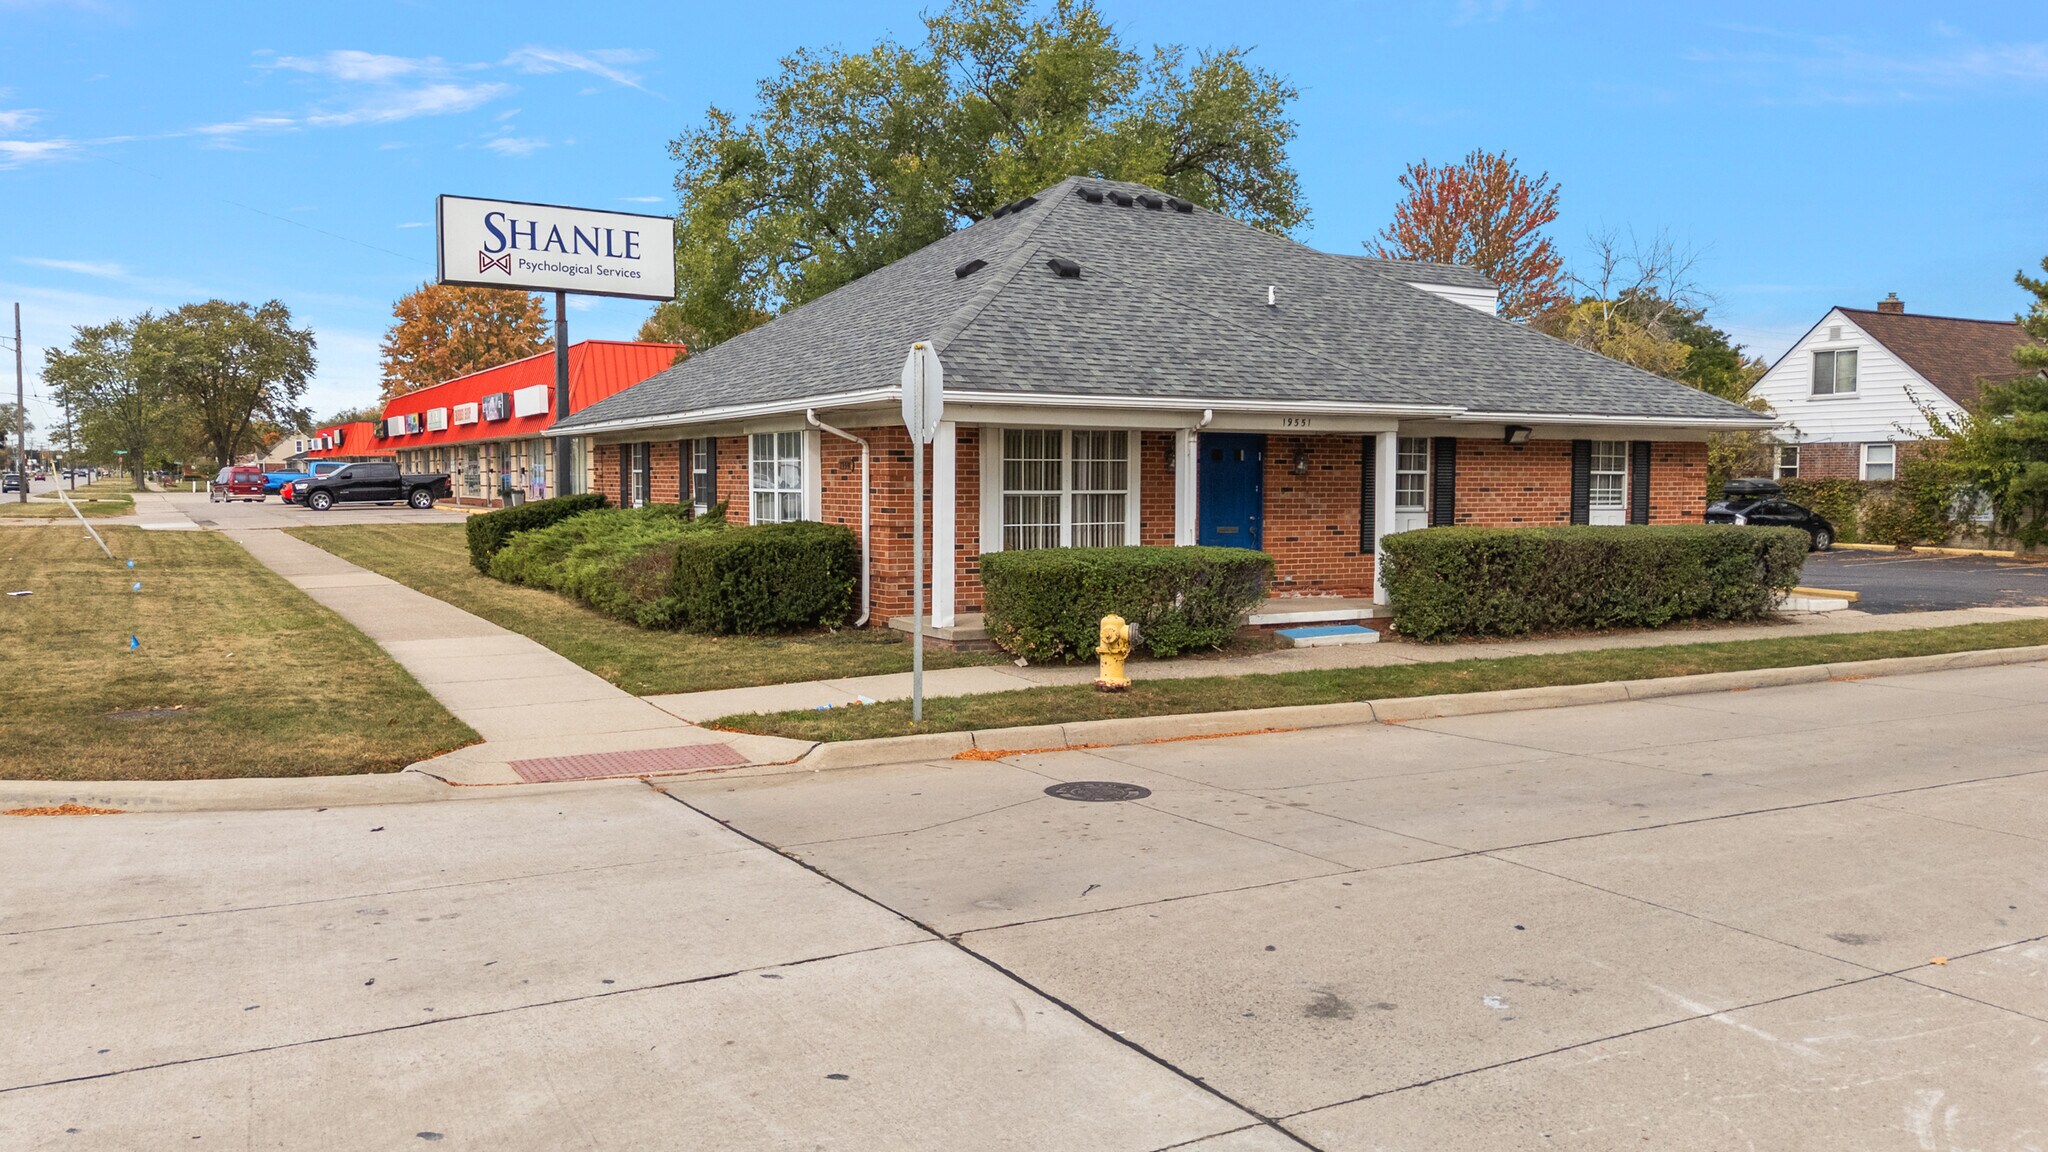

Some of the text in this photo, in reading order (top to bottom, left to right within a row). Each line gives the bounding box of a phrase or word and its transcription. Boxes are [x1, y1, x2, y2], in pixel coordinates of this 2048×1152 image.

[484, 211, 641, 260] SHANLE
[519, 258, 642, 279] Psychological Services
[1282, 417, 1311, 427] 19551
